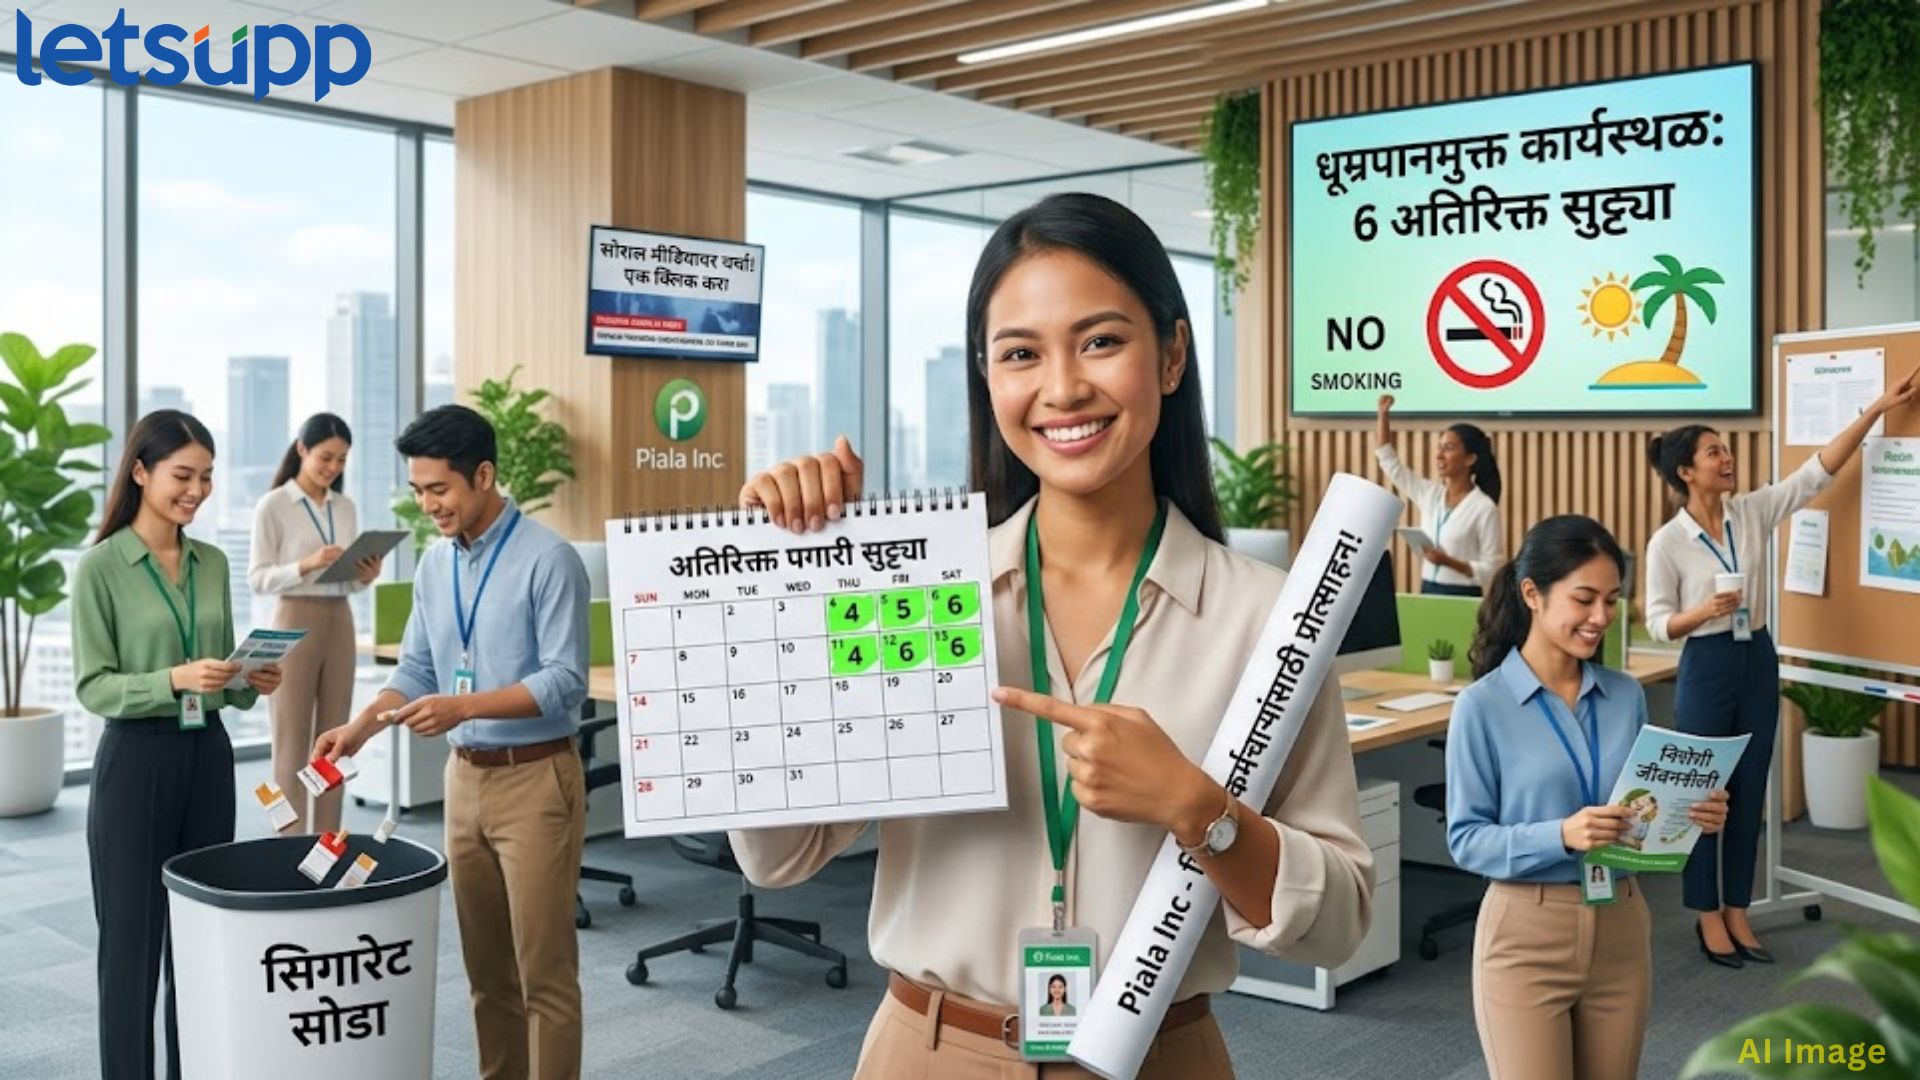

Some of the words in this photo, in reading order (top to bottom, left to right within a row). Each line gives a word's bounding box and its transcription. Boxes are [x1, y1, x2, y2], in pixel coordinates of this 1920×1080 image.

[1316, 132, 1509, 196] धूम्रपानमुक्त
[1520, 107, 1725, 163] कार्यस्थळ:
[1353, 204, 1378, 242] 6
[1391, 185, 1550, 238] अतिरिक्त
[1561, 183, 1676, 240] सुट्ट्या
[1326, 316, 1385, 351] NO
[1310, 372, 1402, 391] SMOKING
[636, 447, 687, 469] Piala
[693, 448, 724, 469] Inc
[669, 545, 779, 577] अतिरिक्त
[786, 536, 854, 568] पगारी
[861, 538, 927, 571] सुट्ट्या
[634, 593, 658, 604] SUN
[684, 589, 710, 600] MON
[737, 585, 758, 596] TUE
[785, 581, 811, 592] WED
[838, 578, 860, 588] THU
[892, 574, 909, 584] FRI
[942, 569, 962, 579] SAT
[1293, 529, 1363, 643] प्रोत्साहन!
[676, 609, 682, 619] 1
[727, 605, 735, 616] 2
[778, 601, 785, 612] 3
[844, 602, 859, 622] 4
[897, 598, 911, 620] 5
[947, 594, 963, 615] 6
[629, 654, 637, 664] 7
[679, 650, 687, 661] 8
[730, 646, 737, 657] 9
[781, 642, 795, 653] 10
[831, 639, 843, 649] 11
[848, 645, 863, 666] 4
[883, 634, 897, 645] 12
[899, 641, 914, 662] 6
[950, 637, 966, 657] 6
[633, 696, 647, 706] 14
[682, 693, 696, 703] 15
[732, 689, 746, 700] 16
[784, 684, 797, 695] 17
[886, 676, 900, 687] 19
[937, 672, 953, 683] 20
[635, 739, 649, 750] 21
[684, 735, 699, 745] 22
[735, 731, 750, 742] 23
[786, 727, 801, 738] 24
[838, 722, 853, 734] 25
[888, 718, 904, 729] 26
[940, 714, 955, 726] 27
[687, 778, 702, 788] 29
[738, 774, 753, 784] 30
[789, 770, 803, 781] 31
[260, 934, 413, 993] सिगारेट
[1117, 944, 1170, 1015] Piala
[1153, 895, 1191, 941] Inc
[289, 996, 390, 1047] सोडा
